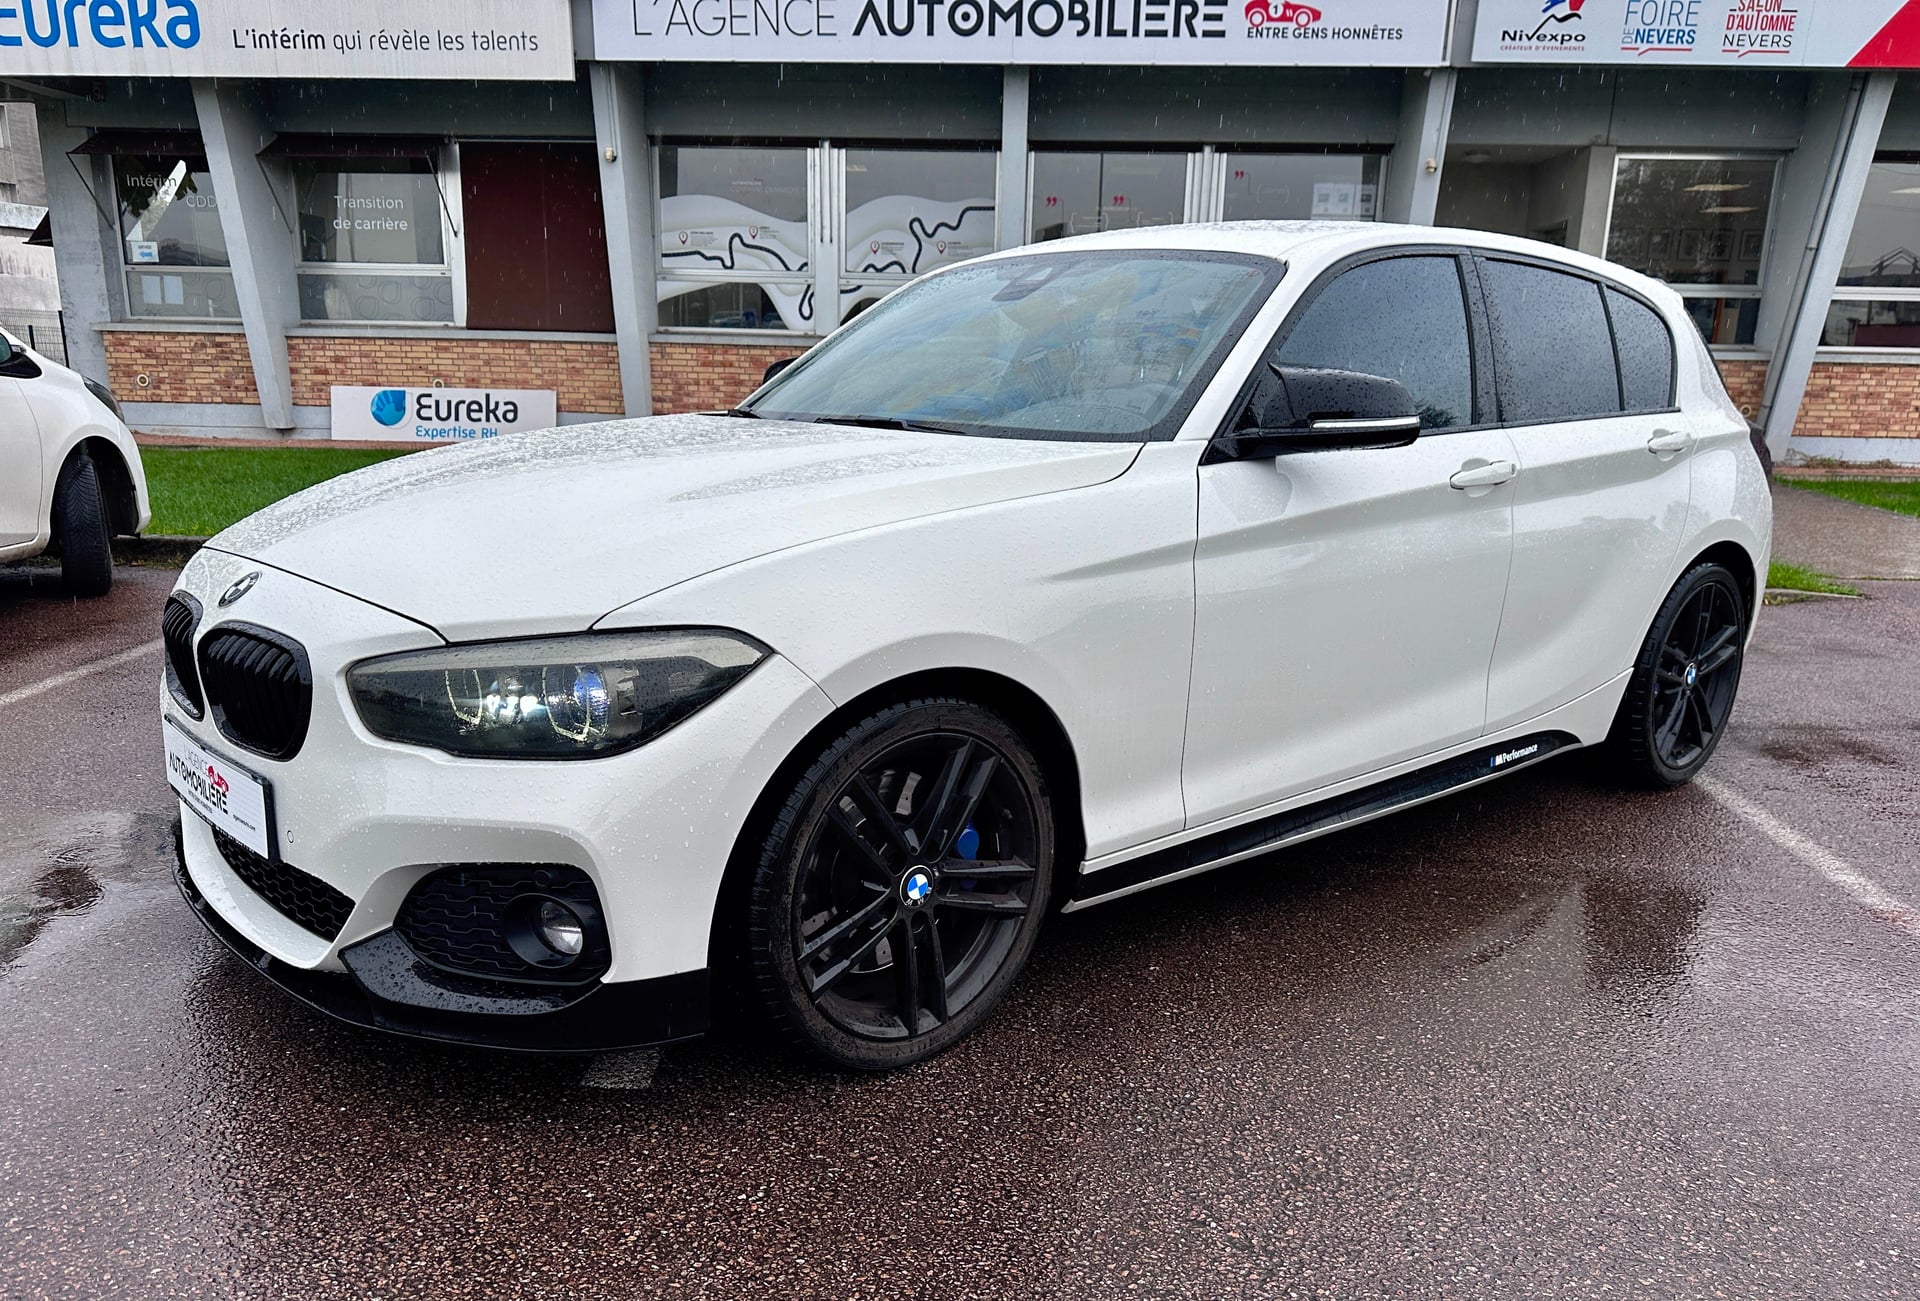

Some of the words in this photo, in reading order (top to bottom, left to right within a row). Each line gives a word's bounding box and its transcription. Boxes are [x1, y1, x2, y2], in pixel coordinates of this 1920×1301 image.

[633, 0, 837, 36] L'AGENCE
[1624, 0, 1700, 26] FOIRE
[1726, 10, 1797, 31] D'AUTOMNE
[232, 27, 326, 50] L'intérim
[333, 30, 362, 55] qui
[369, 28, 430, 51] révèle
[437, 29, 465, 51] les
[471, 29, 539, 51] talents
[1247, 26, 1289, 39] ENTRE
[1292, 27, 1328, 39] GENS
[1332, 25, 1403, 40] HONNÊTES
[1501, 23, 1586, 45] Nivexpo
[1634, 28, 1697, 45] NEVERS
[1722, 33, 1793, 48] NEVERS
[126, 174, 177, 187] Intérim
[334, 195, 404, 209] Transition
[333, 216, 351, 229] de
[354, 217, 408, 230] carrière
[416, 393, 519, 424] Eureka
[416, 425, 476, 440] Expertise
[481, 428, 498, 438] RH
